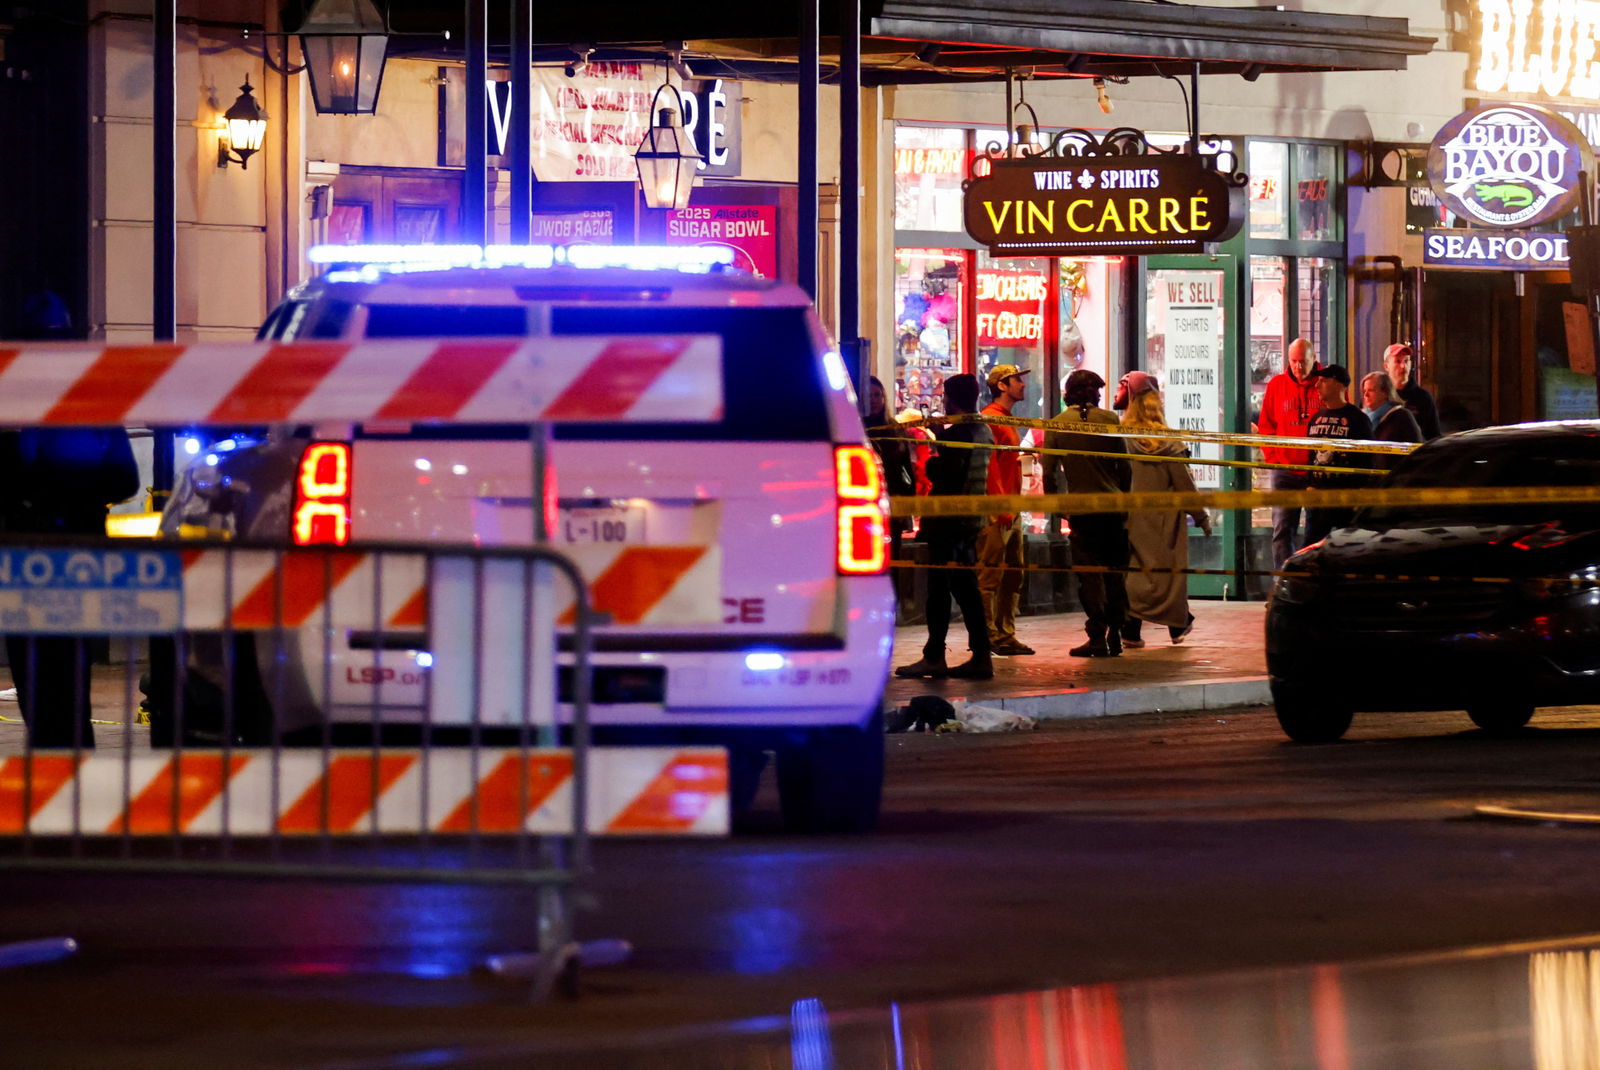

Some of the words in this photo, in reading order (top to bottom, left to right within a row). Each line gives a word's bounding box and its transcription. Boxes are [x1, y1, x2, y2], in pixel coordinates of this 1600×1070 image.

[1475, 0, 1600, 99] BLUE
[1469, 124, 1542, 147] BLUE
[575, 153, 606, 177] SOLD
[1444, 147, 1566, 184] BAYOU
[1034, 170, 1073, 190] WINE
[1100, 168, 1160, 189] SPIRITS
[676, 207, 711, 220] 2025
[714, 208, 760, 219] Allstate
[983, 200, 1056, 235] VIN
[1066, 189, 1212, 234] CARRÉ
[669, 219, 721, 238] SUGAR
[725, 219, 770, 238] BOWL
[1168, 282, 1184, 303] WE
[1189, 282, 1215, 303] SELL
[1174, 318, 1209, 332] T-SHIRTS
[1169, 369, 1185, 385] KID'S
[1187, 368, 1214, 385] CLOTHING
[1182, 393, 1202, 410] HATS
[1179, 417, 1205, 431] MASKS
[1330, 425, 1349, 436] LIST
